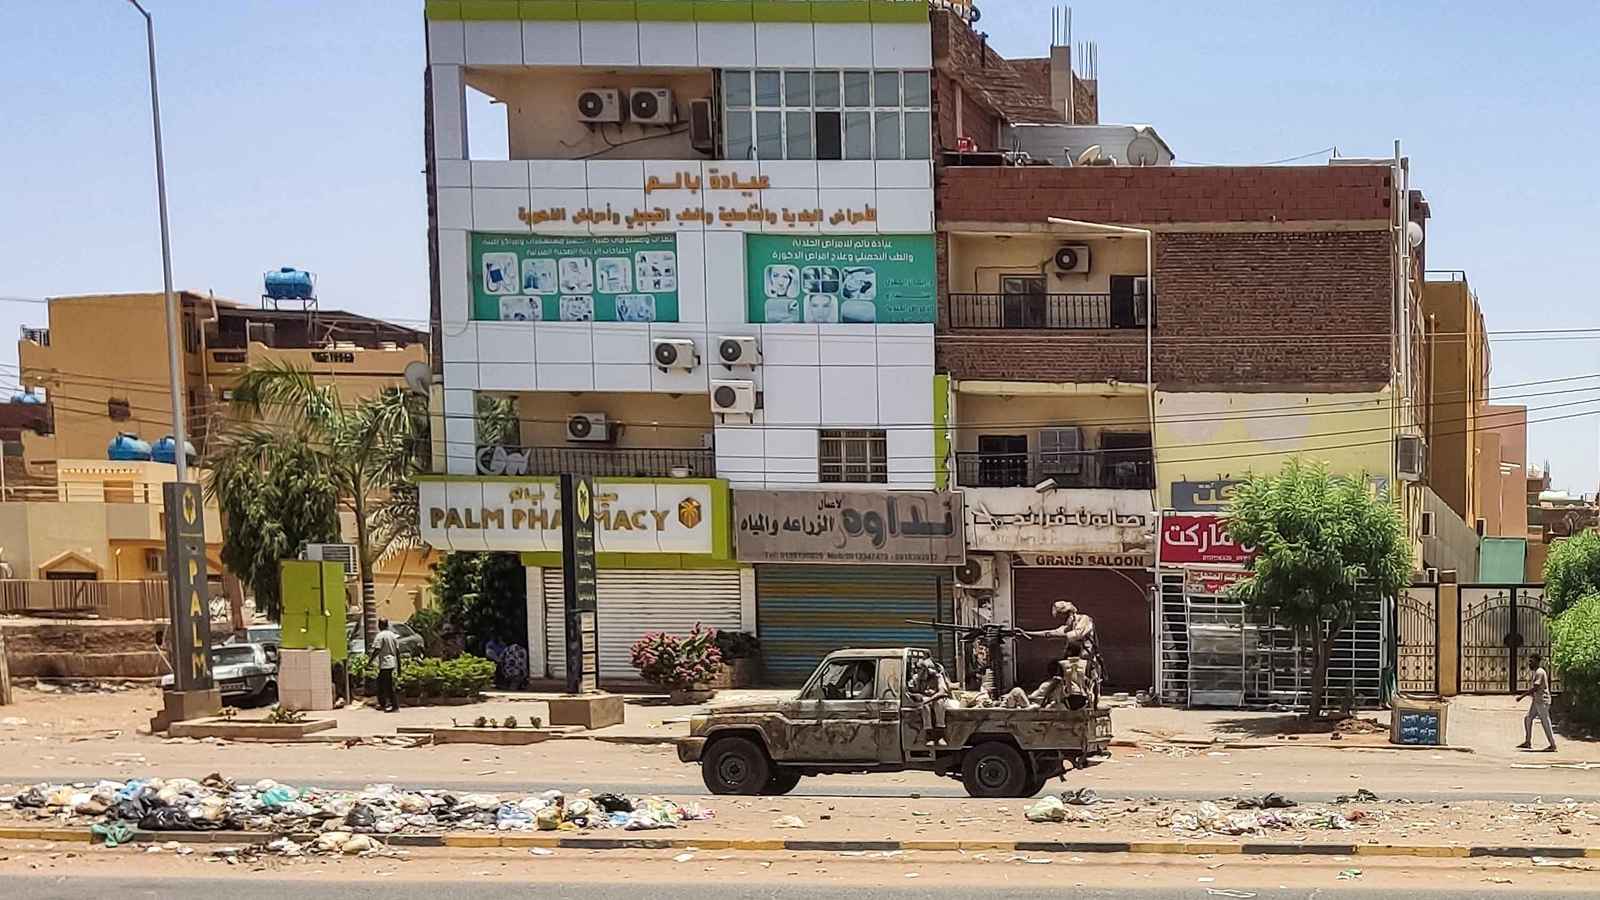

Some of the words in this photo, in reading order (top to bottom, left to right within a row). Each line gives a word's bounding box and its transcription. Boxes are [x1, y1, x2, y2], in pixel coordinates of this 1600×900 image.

[709, 168, 769, 197] عيادة
[430, 507, 504, 530] PALM
[512, 508, 670, 531] PHAMACY
[1076, 506, 1140, 529] صالون
[1036, 555, 1083, 567] GRAND
[1088, 556, 1144, 567] SALOON
[189, 559, 206, 679] PALM
